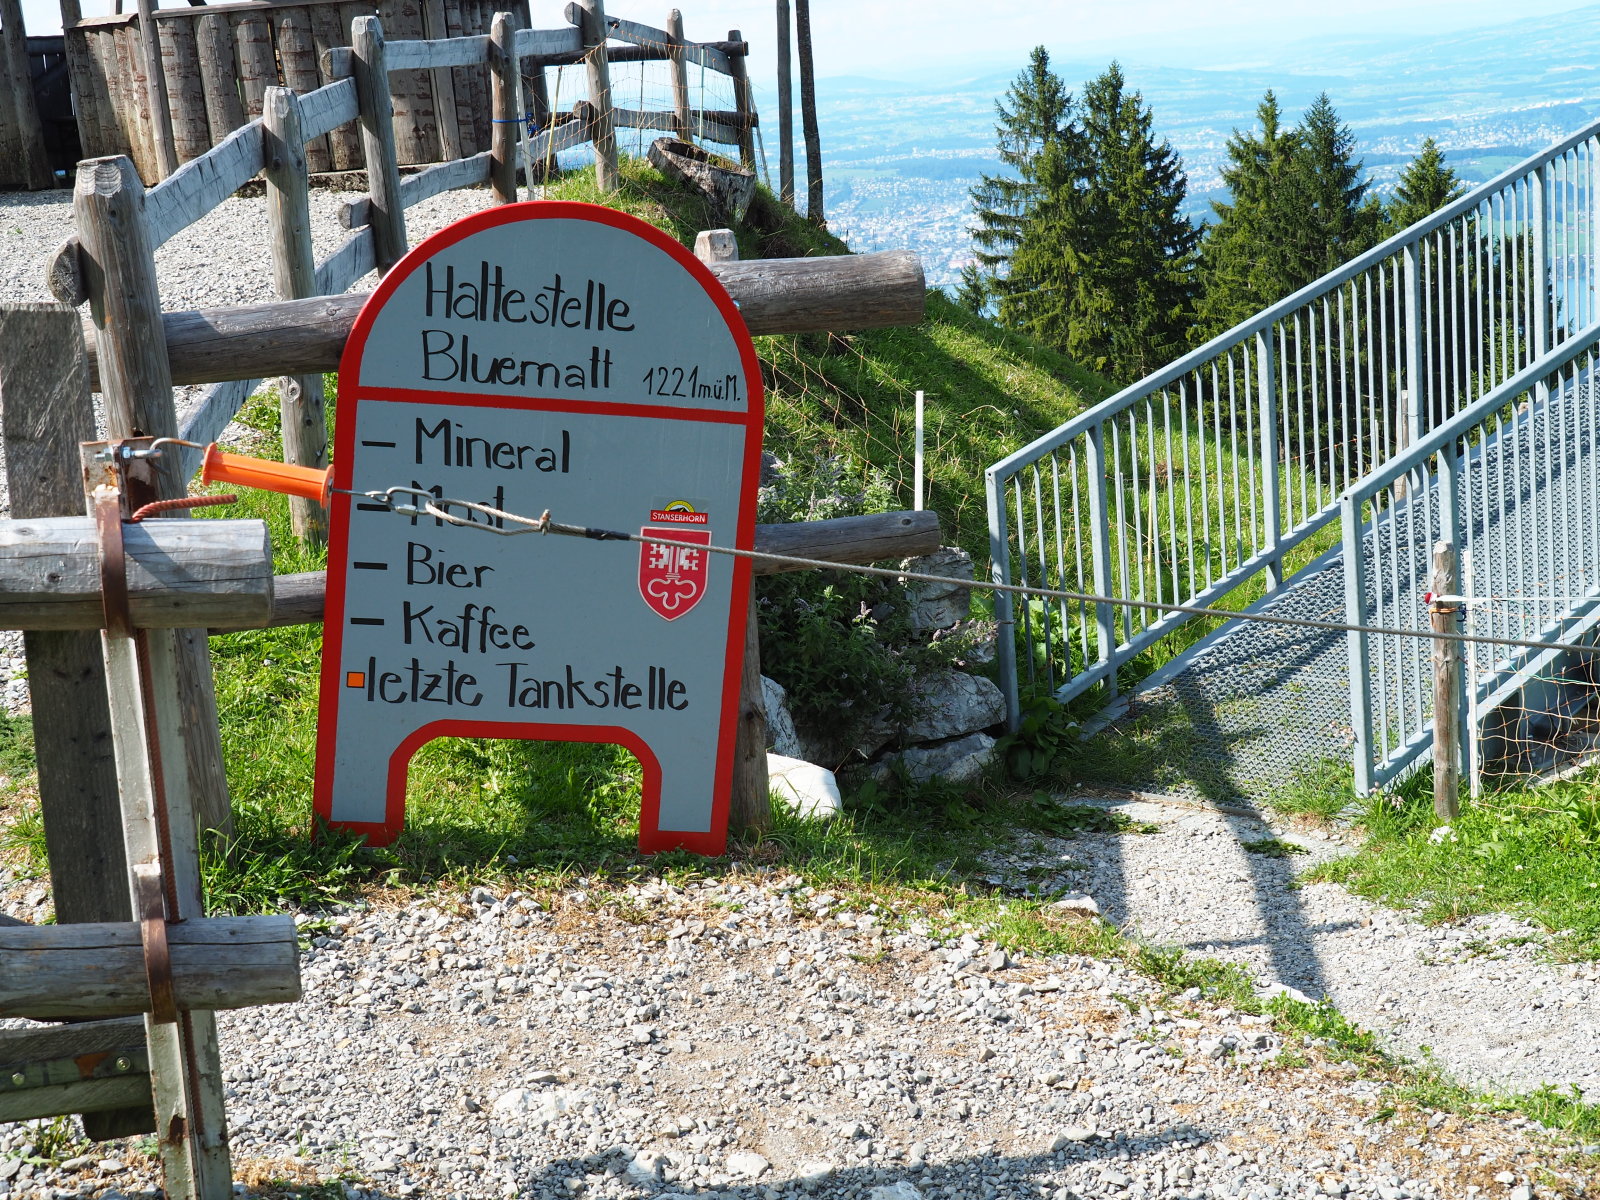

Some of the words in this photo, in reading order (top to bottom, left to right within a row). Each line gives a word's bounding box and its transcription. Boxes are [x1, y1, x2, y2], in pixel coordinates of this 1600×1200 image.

[425, 260, 636, 332] Haltestelle
[422, 329, 613, 389] Bluematt
[415, 417, 570, 474] Mineral
[652, 511, 706, 523] STANSERHORN
[407, 541, 495, 588] Bier
[403, 600, 536, 654] Kaffee
[368, 656, 484, 707] letzte
[496, 662, 689, 711] Tankstelle
